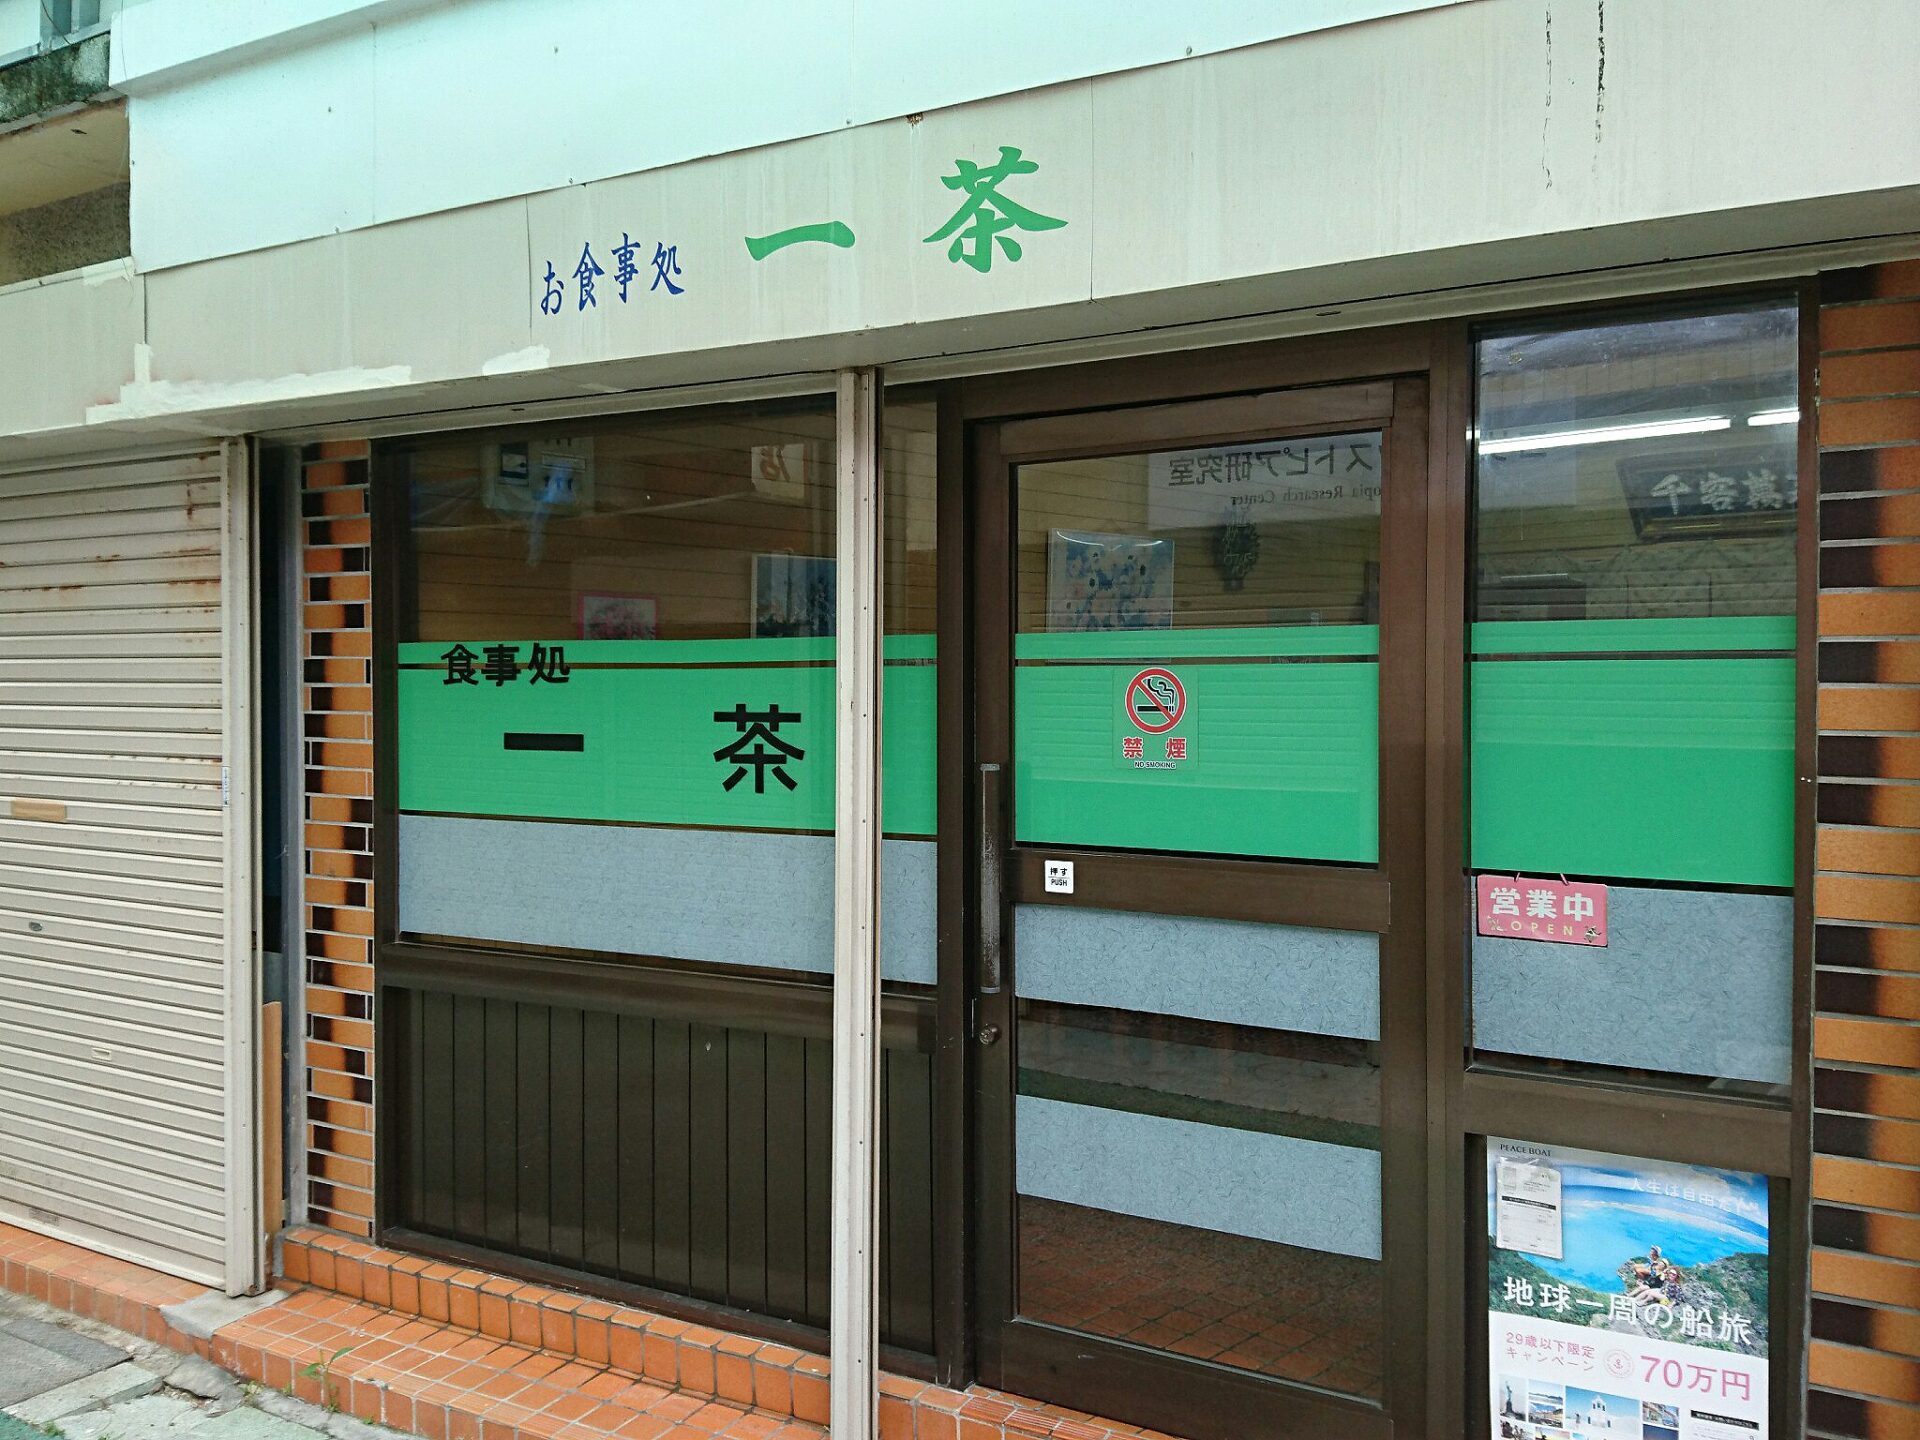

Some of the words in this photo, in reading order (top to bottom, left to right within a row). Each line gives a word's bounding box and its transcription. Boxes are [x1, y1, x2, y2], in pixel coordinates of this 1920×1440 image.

[540, 233, 686, 316] お食事処
[440, 642, 571, 687] 食事処
[1123, 737, 1186, 760] 禁煙
[1146, 761, 1176, 769] SMOKING
[1050, 867, 1068, 877] 押す
[1050, 878, 1068, 887] PUSH
[1490, 887, 1594, 921] 営業中
[1510, 921, 1573, 937] OPEN
[1500, 1144, 1527, 1154] PEACE
[1528, 1147, 1552, 1157] BOAT
[1503, 1276, 1752, 1345] 地球一周の船旅
[1505, 1331, 1596, 1359] 29歳以下限定
[1506, 1346, 1595, 1372] キャンペーン
[1640, 1354, 1751, 1401] 70万円
